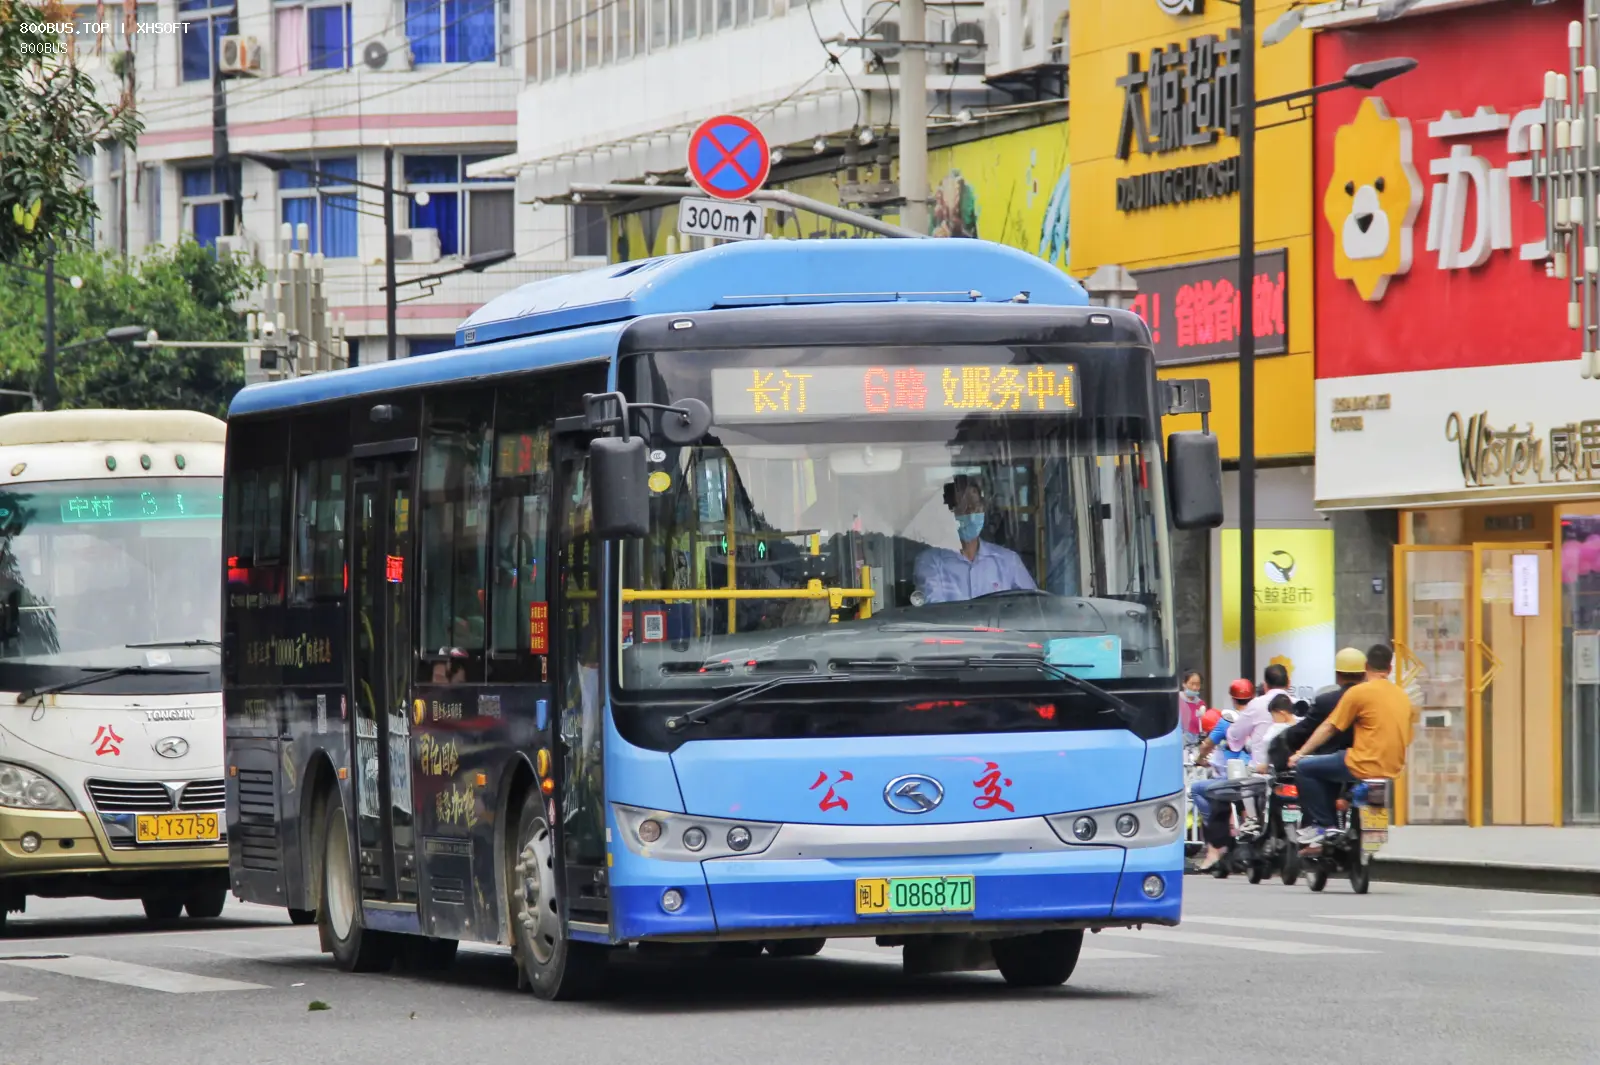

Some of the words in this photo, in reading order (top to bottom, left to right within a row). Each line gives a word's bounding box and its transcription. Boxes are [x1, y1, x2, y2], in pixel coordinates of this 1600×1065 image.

[1115, 28, 1241, 162] 大鲸超市
[686, 206, 740, 232] 300m
[745, 369, 813, 413] 长汀
[69, 495, 114, 517] 中村
[145, 709, 196, 722] TONGXIN
[91, 724, 124, 757] 公
[808, 770, 854, 812] 公
[973, 761, 1015, 813] 交
